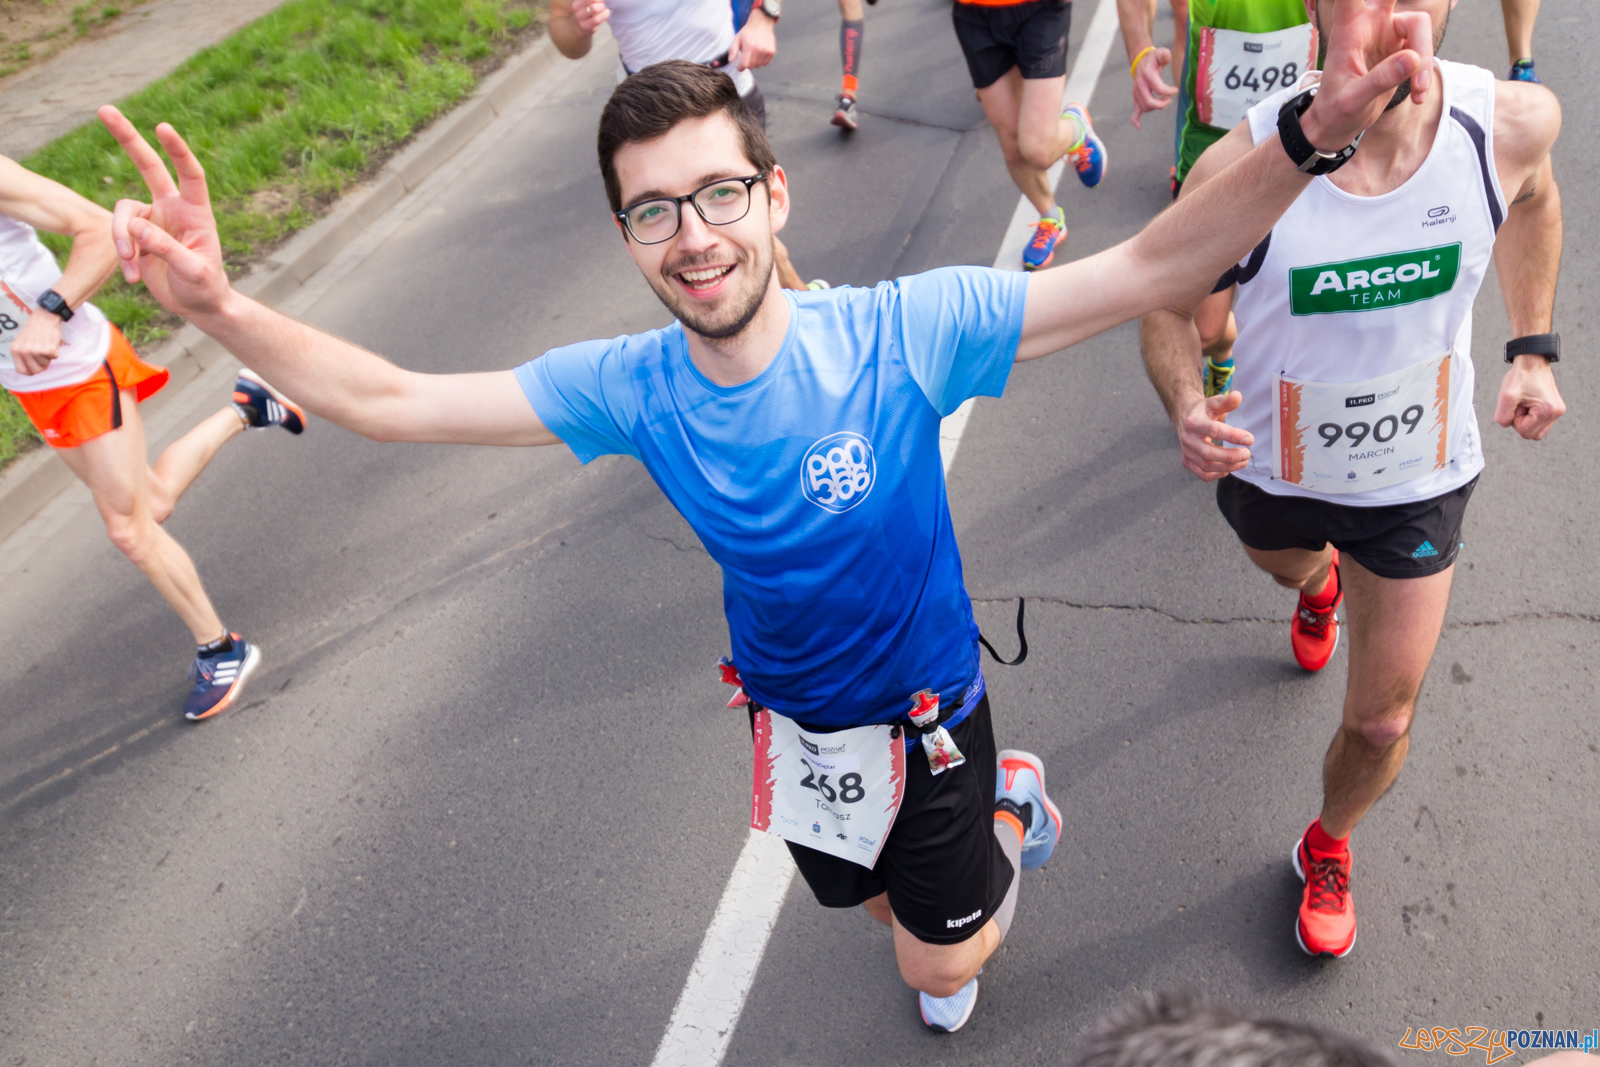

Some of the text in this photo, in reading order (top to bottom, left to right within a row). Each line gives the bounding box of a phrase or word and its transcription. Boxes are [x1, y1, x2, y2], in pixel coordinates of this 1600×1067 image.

[1224, 62, 1298, 92] 6498
[1422, 214, 1457, 228] Kalenji
[1309, 260, 1441, 296] ARGOL
[1350, 288, 1401, 305] TEAM
[0, 313, 19, 334] 8
[1318, 404, 1425, 448] 9909
[1348, 446, 1395, 461] MARCIN
[800, 757, 866, 804] 268
[946, 909, 982, 929] kipsta
